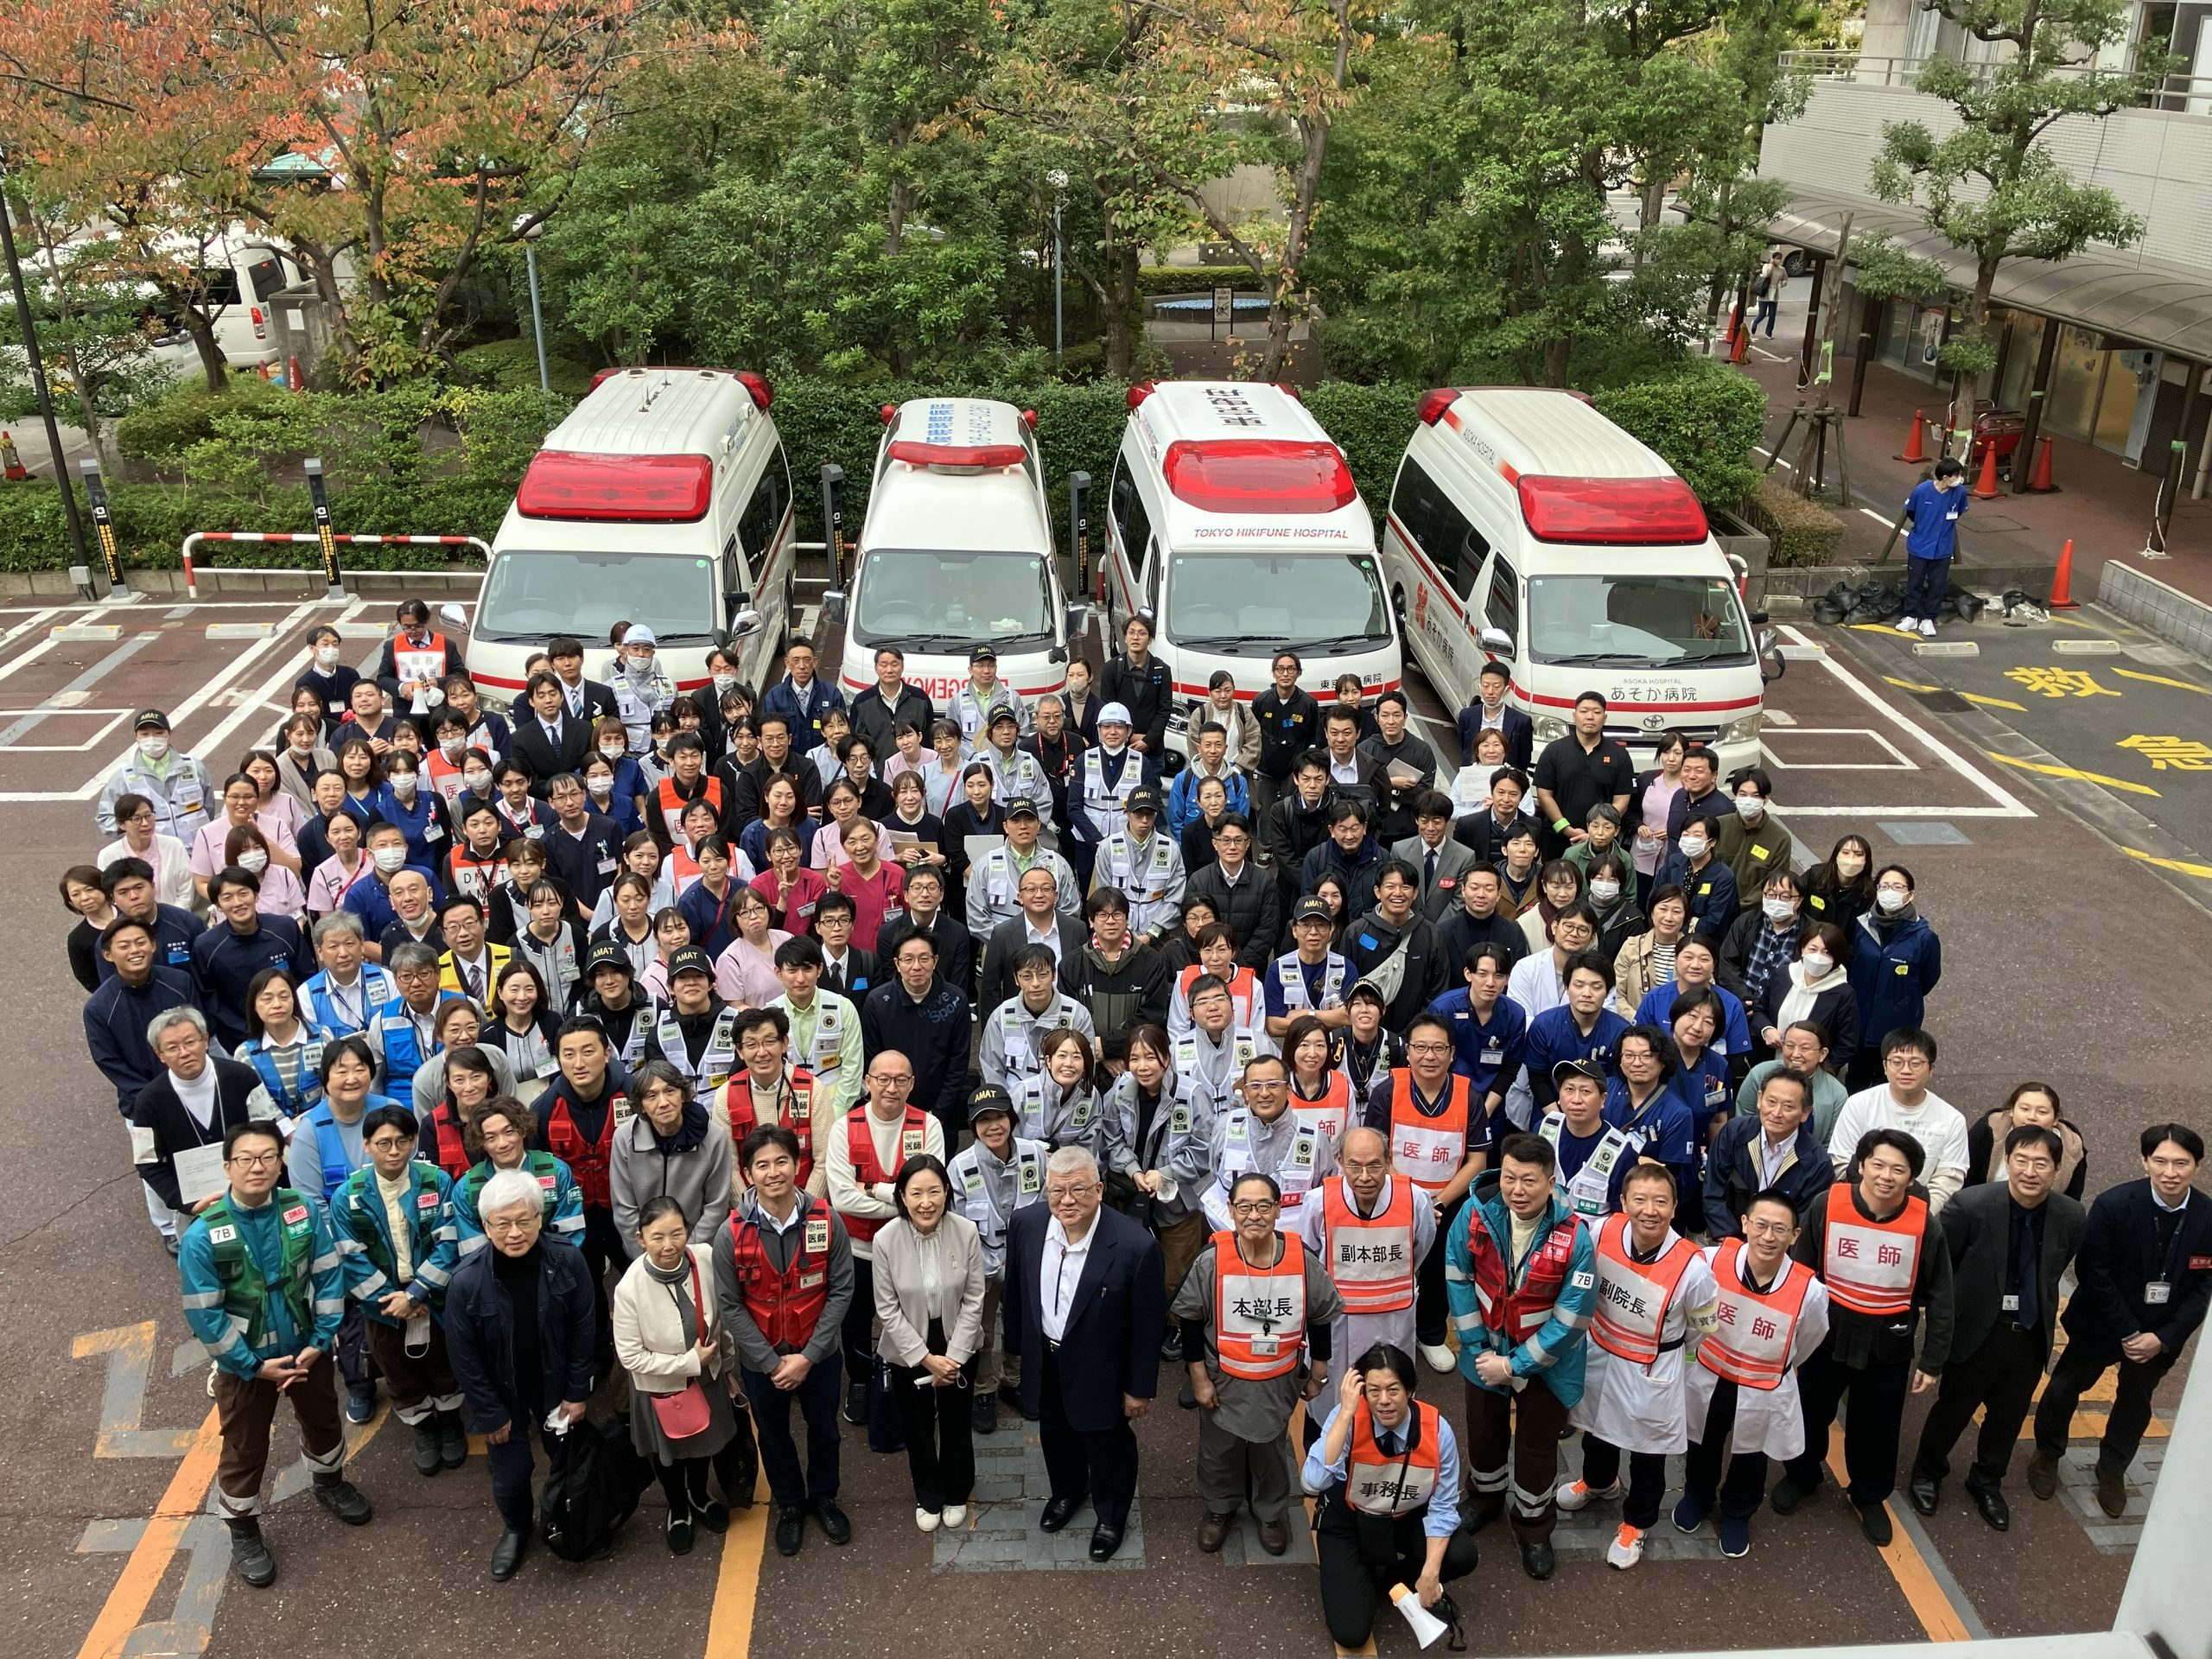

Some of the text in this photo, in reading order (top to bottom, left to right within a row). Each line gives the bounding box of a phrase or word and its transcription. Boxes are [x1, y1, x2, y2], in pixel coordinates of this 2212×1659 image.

[1462, 428, 1497, 466] ASOKA HOSPITAL
[1194, 527, 1349, 539] TOKYO HIKIFUNE HOSPITAL
[1427, 614, 1454, 667] あそか病院
[1611, 687, 1697, 702] あそか病院
[1135, 791, 1152, 800] AMAT
[1304, 899, 1324, 909] AMAT
[593, 947, 614, 958] AMAT
[676, 951, 698, 964] AMAT
[975, 1089, 996, 1103] AMAT
[790, 1100, 808, 1110] 医師
[905, 1141, 922, 1151] 医師
[1403, 1141, 1451, 1164] 医師
[1296, 1155, 1311, 1165] 全日病
[1596, 1161, 1610, 1173] 全日病
[967, 1179, 981, 1189] AMAT
[1024, 1180, 1038, 1191] 全日病
[422, 1194, 437, 1203] DMAT
[288, 1206, 306, 1217] DMAT
[214, 1228, 232, 1241] 7B
[808, 1233, 827, 1244] 医師
[1554, 1233, 1571, 1243] DMAT
[1340, 1244, 1404, 1264] 副本部長
[1838, 1237, 1903, 1268] 医師
[1578, 1274, 1592, 1287] 7B
[1599, 1276, 1647, 1319] 副院長
[1232, 1296, 1294, 1318] 本部長
[1716, 1300, 1777, 1341] 医師
[1360, 1480, 1421, 1502] 事務長
